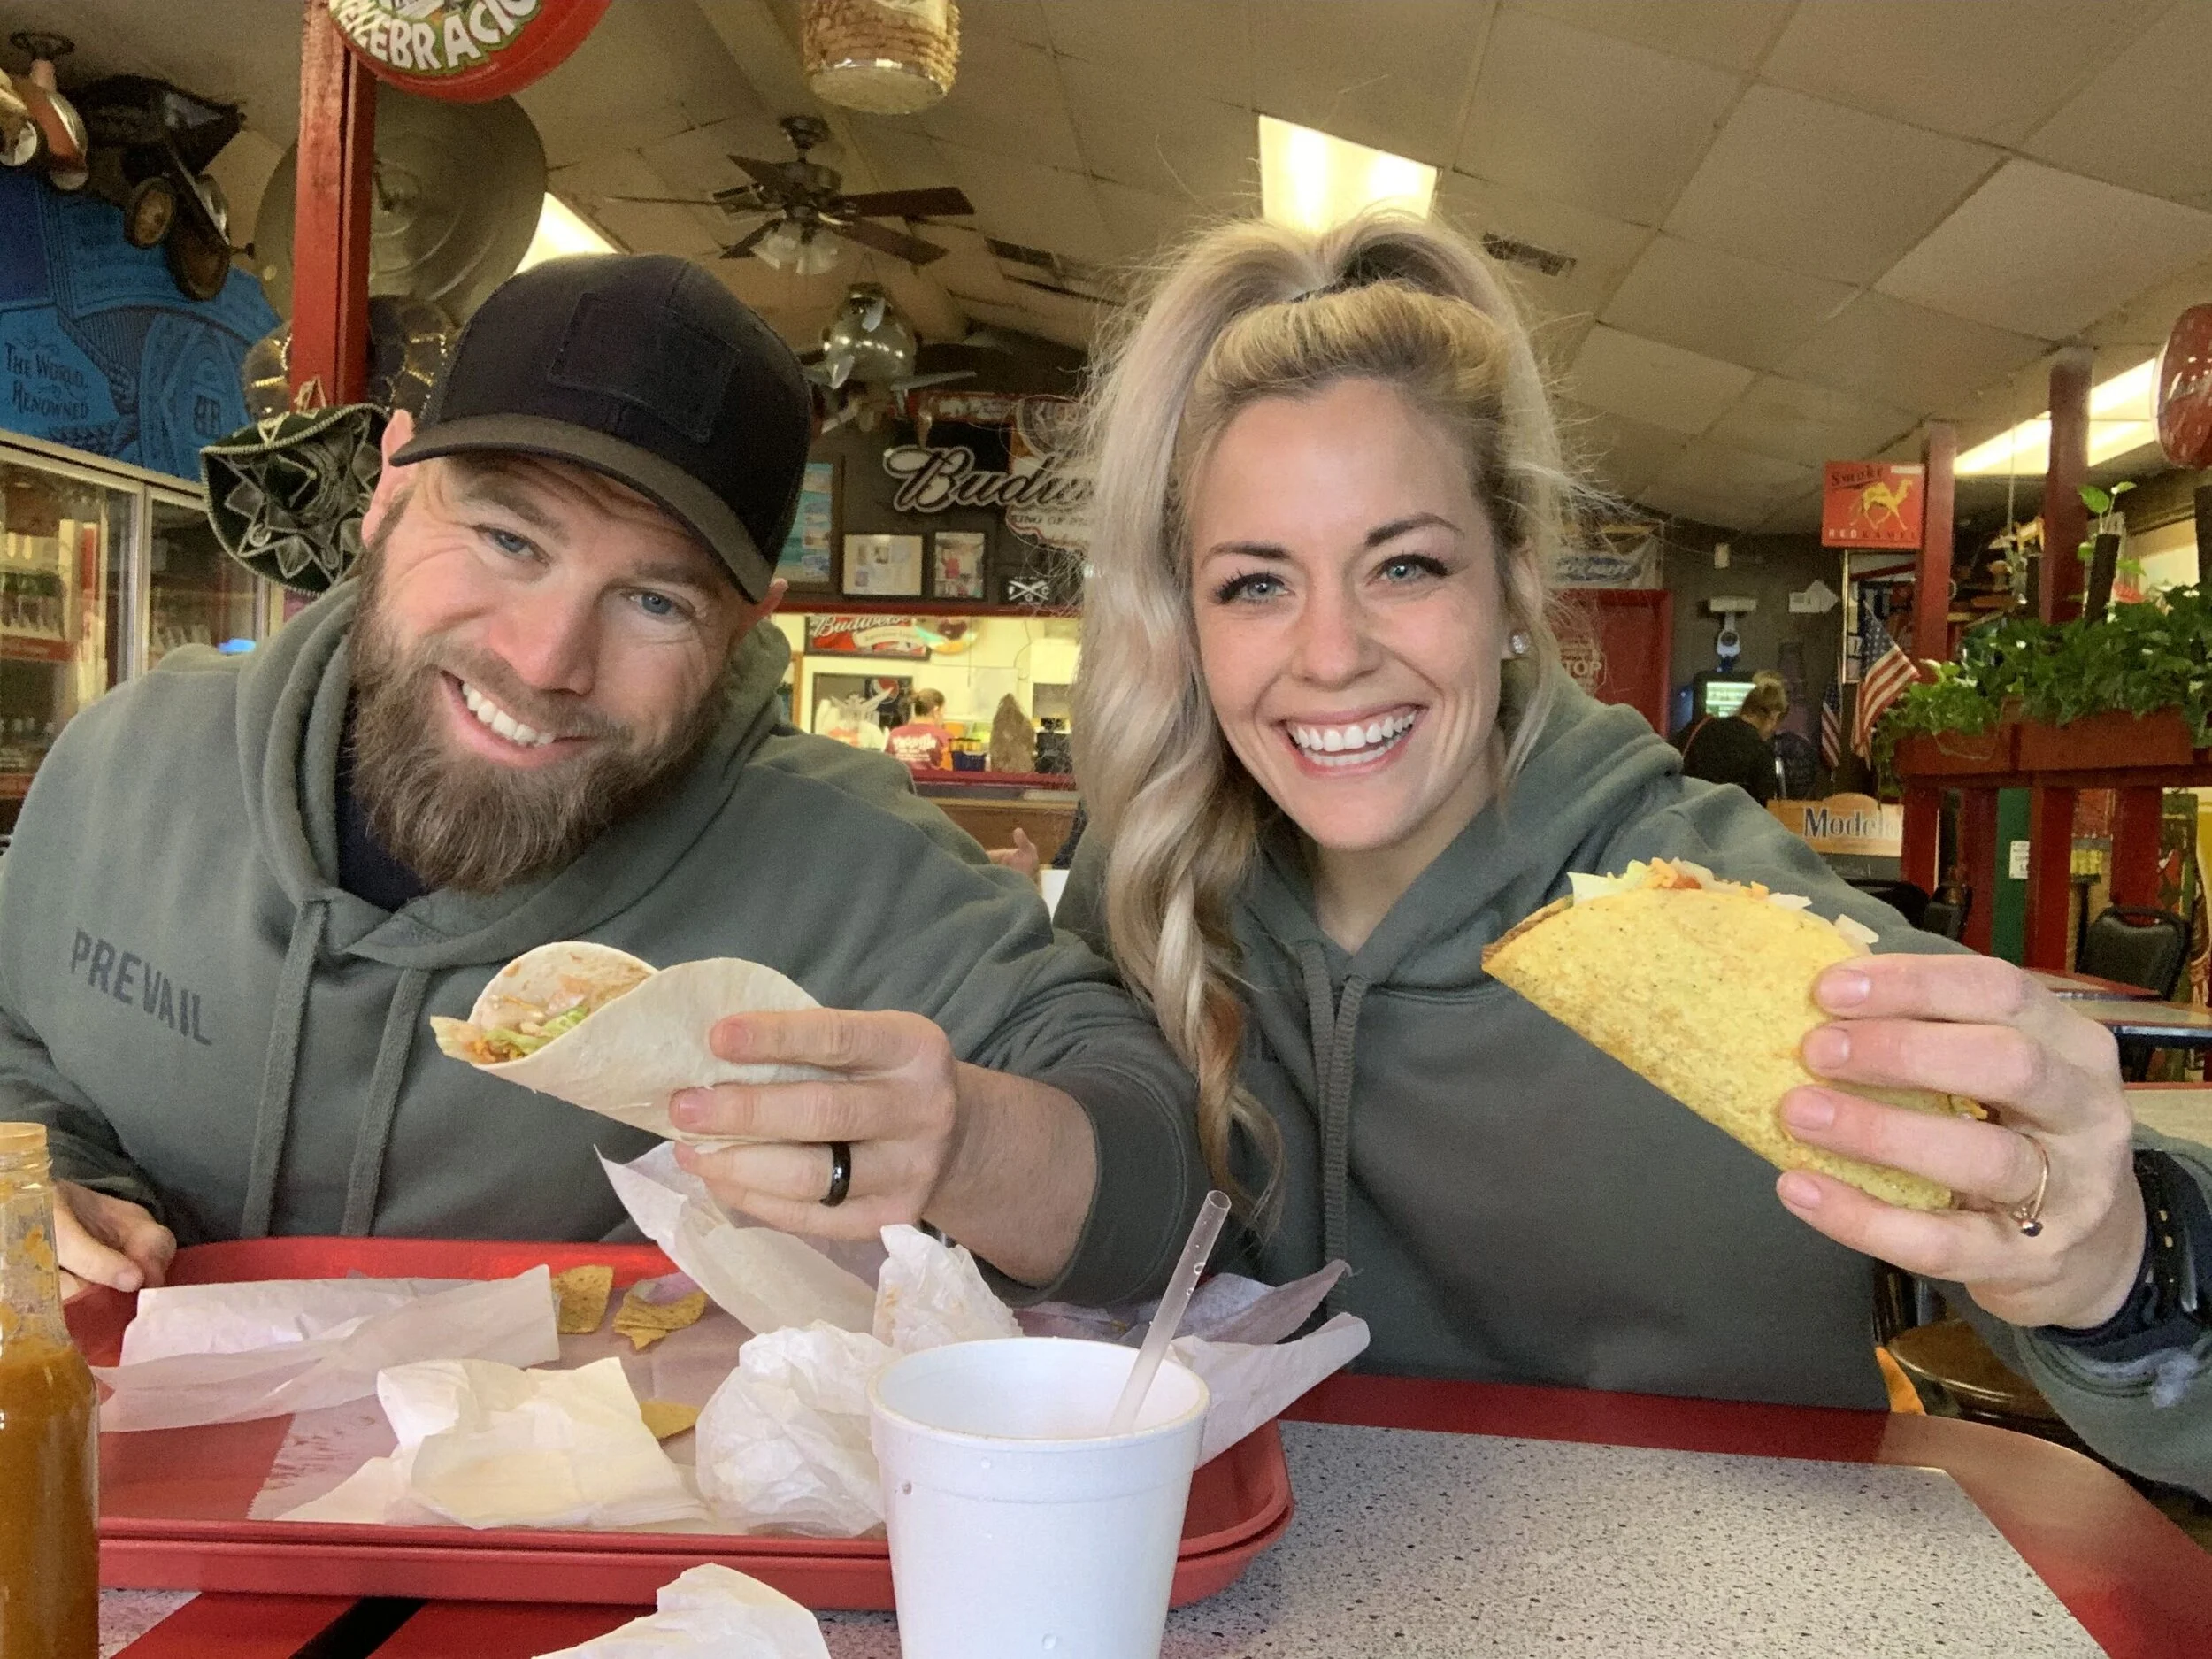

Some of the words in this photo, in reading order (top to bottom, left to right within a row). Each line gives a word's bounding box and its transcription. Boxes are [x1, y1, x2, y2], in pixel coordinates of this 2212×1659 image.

[4, 342, 32, 379] THE
[1828, 528, 1857, 539] RED
[1804, 806, 1901, 838] Modelo
[71, 928, 212, 1046] PREVAIL
